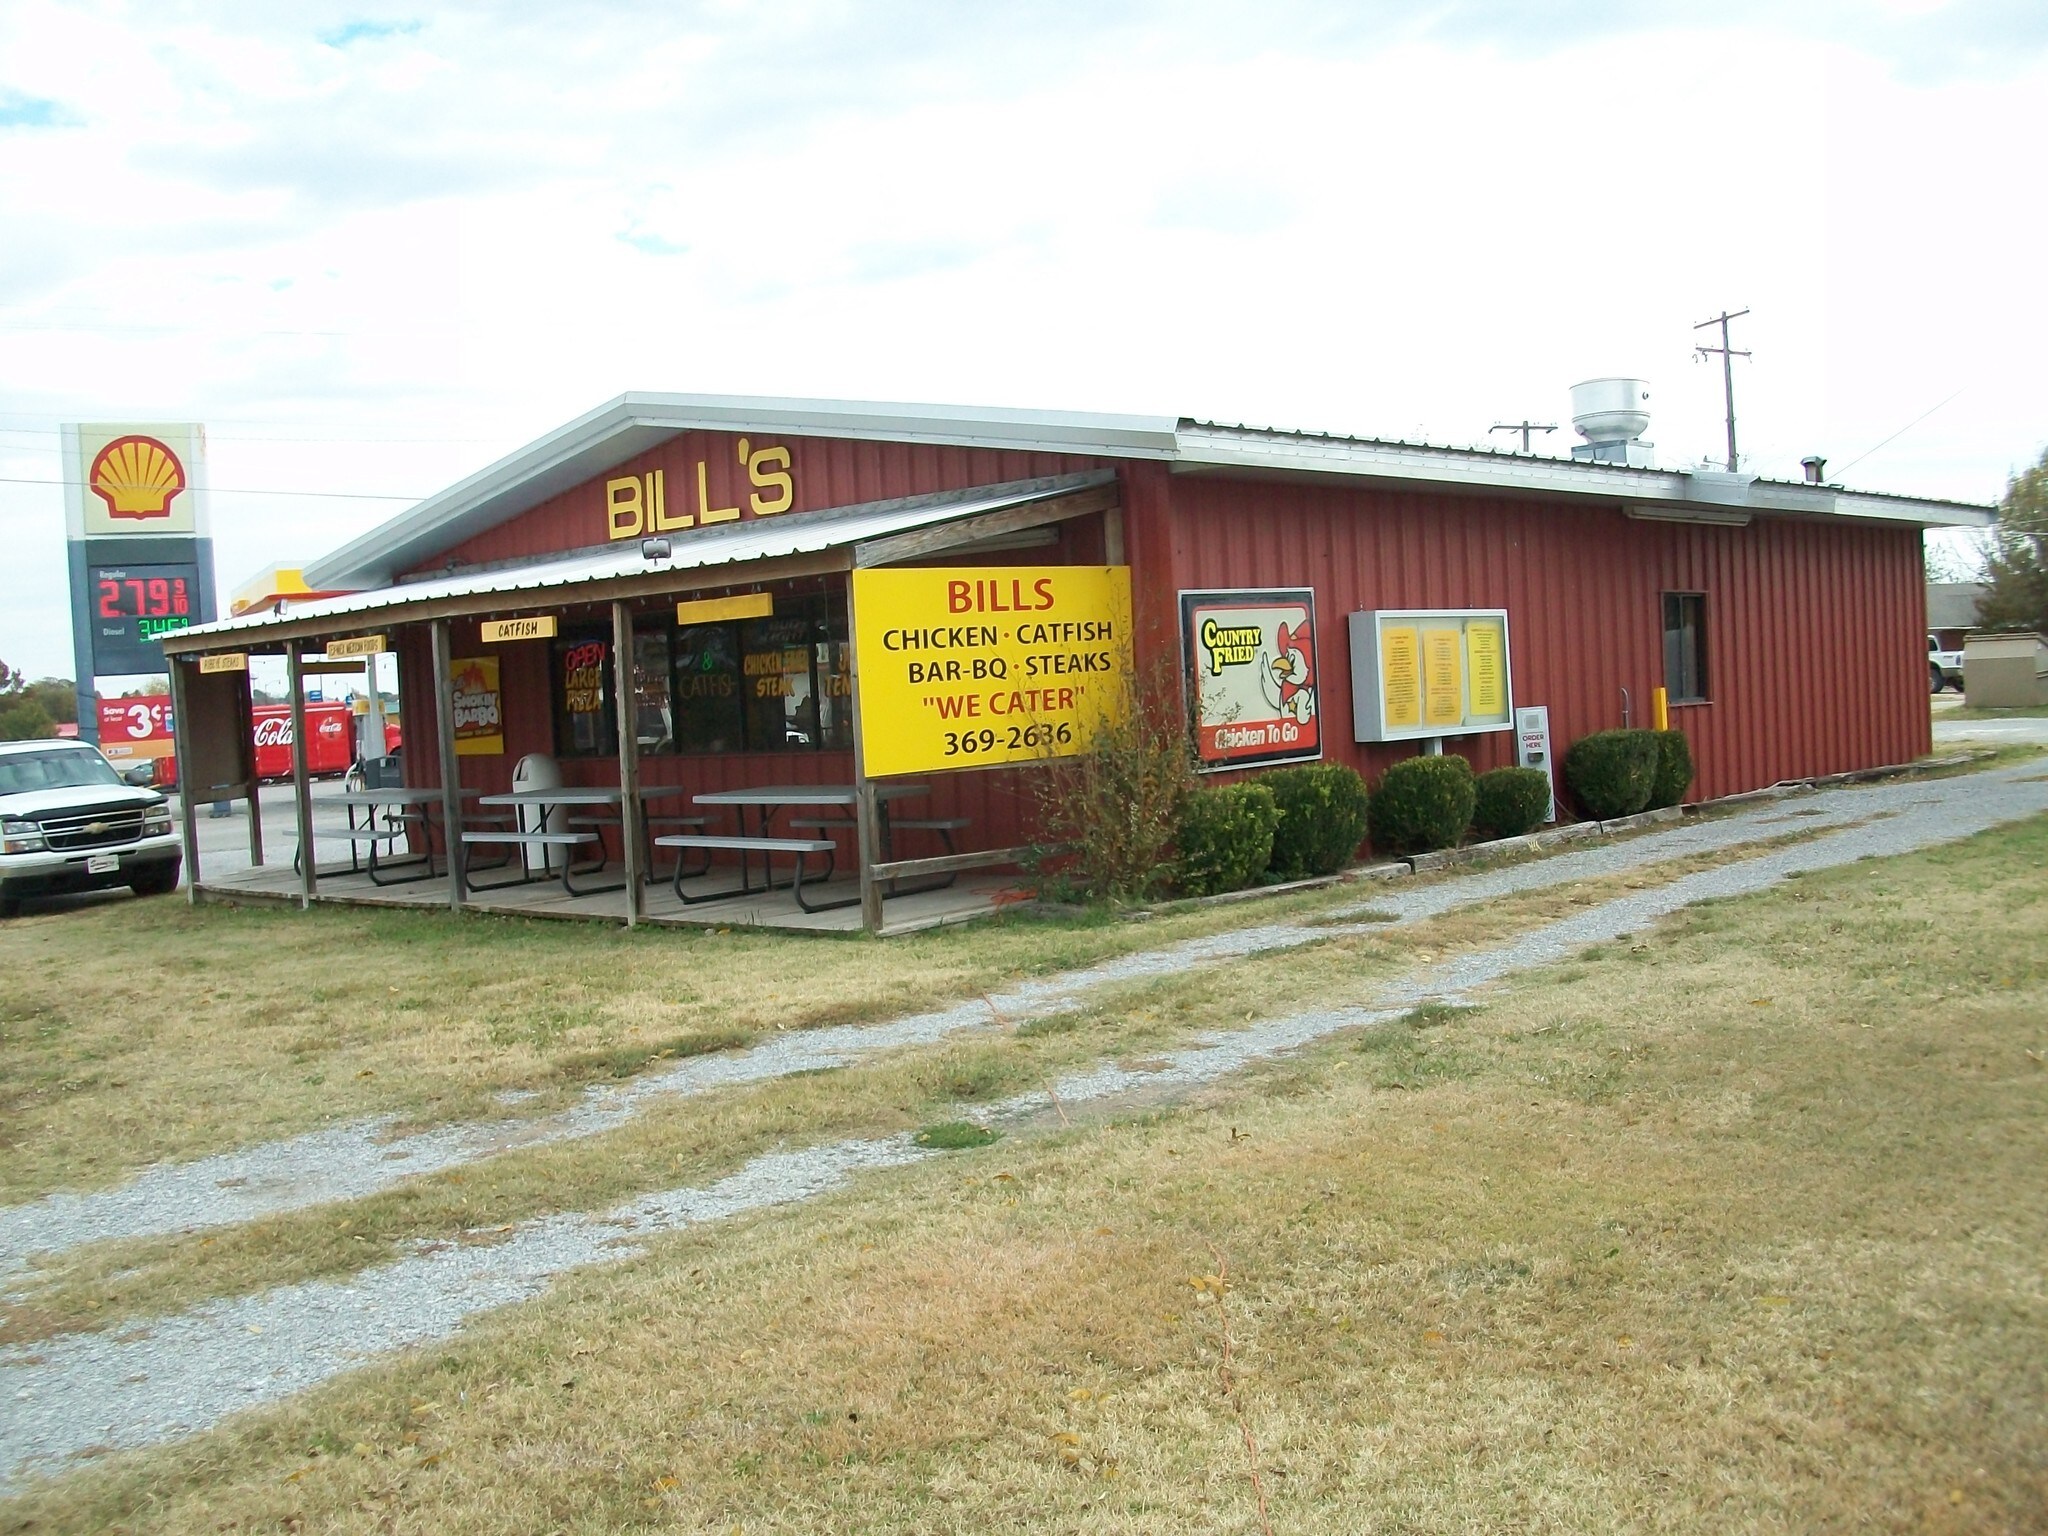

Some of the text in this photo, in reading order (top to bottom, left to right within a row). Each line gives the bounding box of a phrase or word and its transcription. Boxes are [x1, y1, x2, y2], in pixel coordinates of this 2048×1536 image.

[607, 437, 793, 540] BILL'S
[948, 578, 1055, 614] BILLS
[103, 628, 125, 636] Diesel
[498, 621, 538, 637] CATFISH
[883, 621, 1113, 651] CHICKEN CATFISH
[1203, 621, 1261, 648] COUNTRY
[565, 642, 606, 670] OPEN
[743, 652, 782, 675] CHICKEN
[908, 651, 1112, 684] BAR-BQ STEAKS
[1212, 645, 1254, 674] FRIED
[565, 667, 602, 689] LARGE
[756, 678, 796, 698] STEAK
[103, 706, 125, 716] Save
[944, 721, 1073, 757] 369-2636
[1214, 722, 1299, 750] Chicken To Go
[1522, 734, 1544, 742] ORDER
